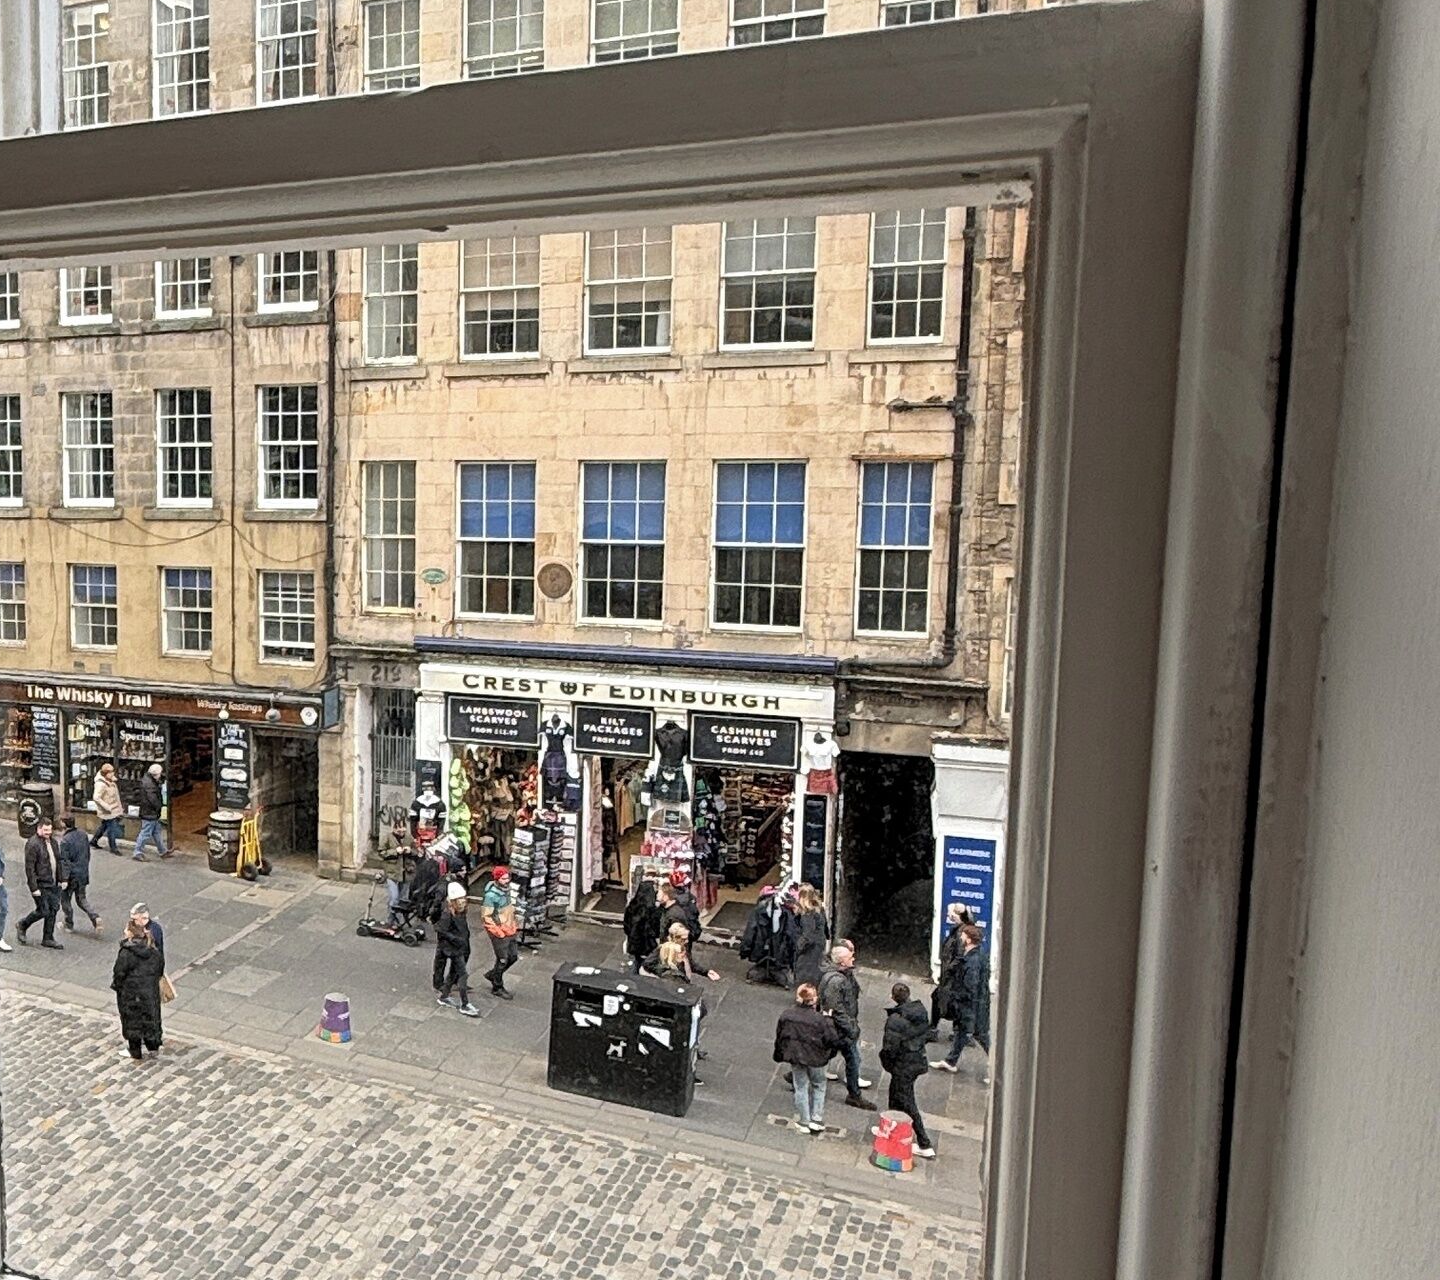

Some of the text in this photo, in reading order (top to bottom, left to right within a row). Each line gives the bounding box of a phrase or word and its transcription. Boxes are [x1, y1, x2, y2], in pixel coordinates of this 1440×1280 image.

[25, 685, 152, 708] The Whisky Trail
[462, 674, 548, 694] CREST
[609, 685, 780, 710] EDINBURGH
[459, 705, 529, 718] LAMBSWOOL
[124, 719, 160, 732] Whisky
[469, 715, 518, 726] SCARVES
[600, 717, 626, 726] KILT
[583, 724, 644, 737] PACKAGES
[710, 725, 777, 739] CASHMERE
[591, 736, 616, 744] FROM
[716, 735, 771, 746] SCARVES
[721, 747, 747, 755] FROM
